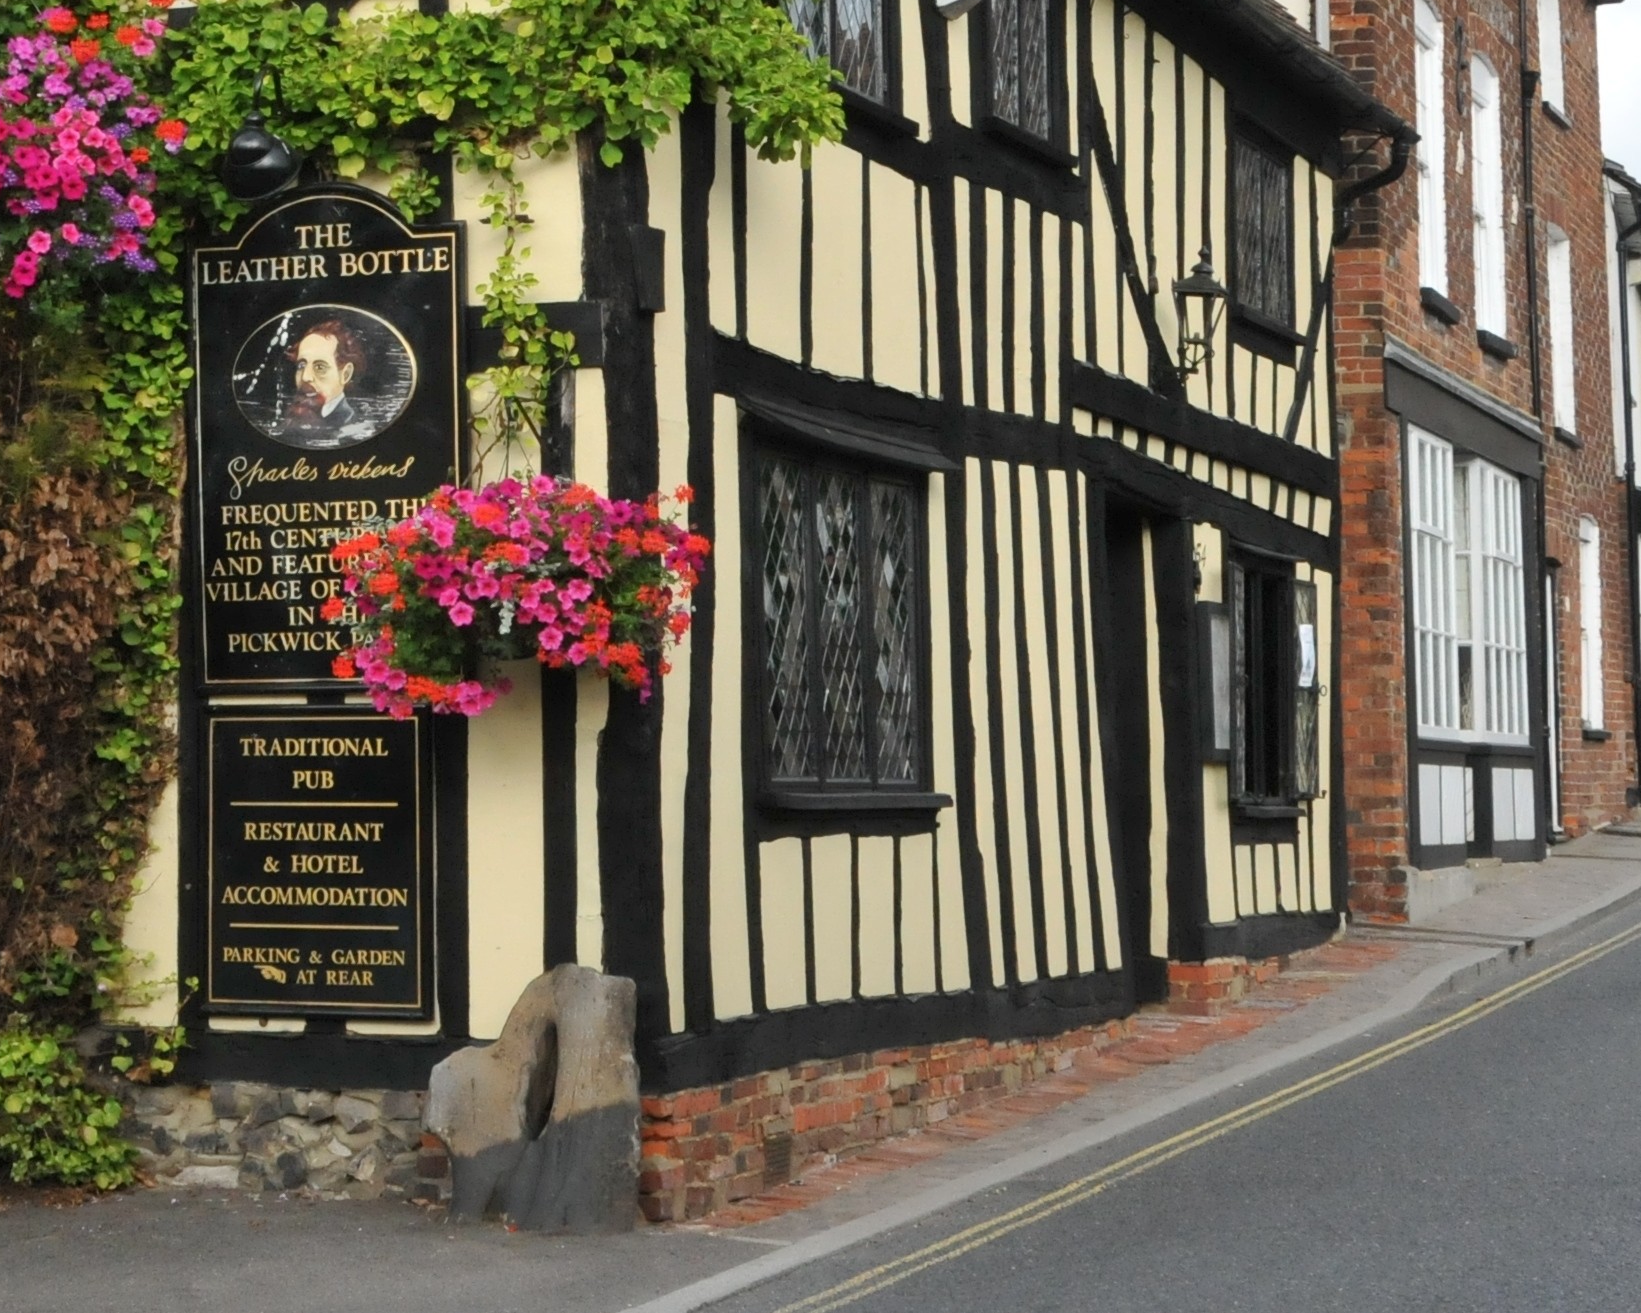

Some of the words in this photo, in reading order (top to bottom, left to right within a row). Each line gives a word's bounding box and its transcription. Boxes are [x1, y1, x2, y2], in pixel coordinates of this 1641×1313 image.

[294, 223, 353, 250] THE
[202, 254, 328, 286] LEATHER
[339, 247, 450, 277] BOTTLE
[220, 500, 378, 527] FREQUENTED
[225, 531, 262, 551] 17th
[270, 527, 368, 550] CENTUR
[211, 556, 263, 577] AND
[206, 580, 303, 602] VILLAGE
[311, 578, 341, 600] OF
[288, 606, 315, 626] IN
[228, 631, 342, 653] PICKWICK
[239, 737, 389, 757] TRADITIONAL
[292, 770, 335, 789] PUB
[244, 822, 384, 842] RESTAURANT
[263, 856, 280, 873] &
[291, 855, 364, 874] HOTEL
[221, 885, 409, 907] ACCOMMODATION
[222, 946, 300, 964] PARKING
[308, 950, 323, 964] &
[331, 949, 406, 966] GARDEN
[296, 969, 317, 985] AT
[326, 970, 374, 986] REAR
